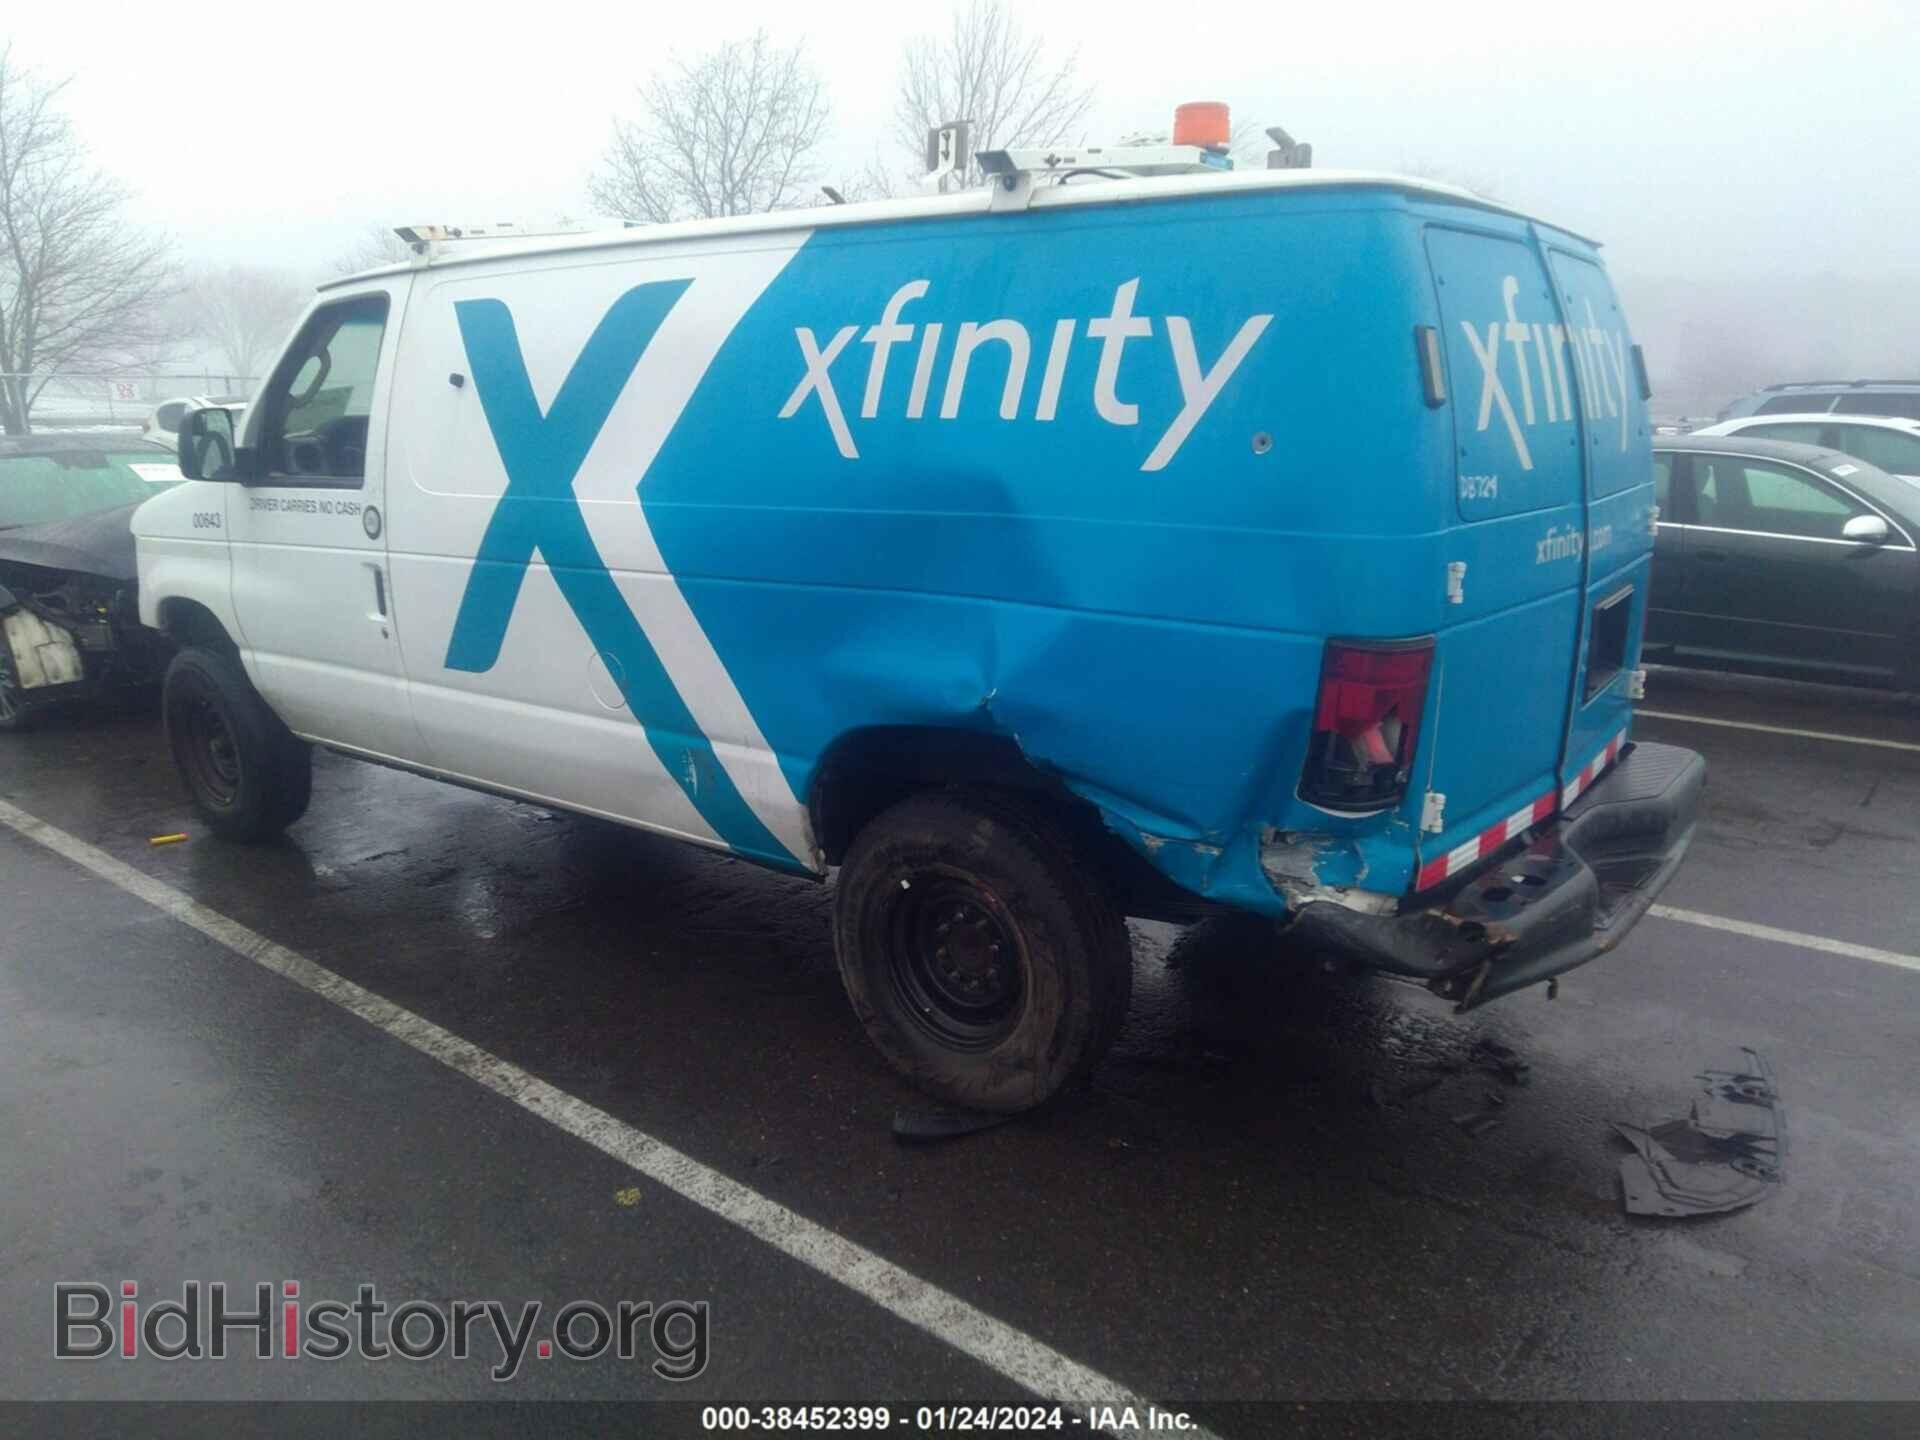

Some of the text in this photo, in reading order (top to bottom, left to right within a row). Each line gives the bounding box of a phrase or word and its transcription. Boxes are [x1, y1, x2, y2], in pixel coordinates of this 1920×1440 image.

[776, 277, 1275, 472] xfinity
[1461, 275, 1628, 471] xfinity
[193, 512, 222, 528] 00643
[250, 497, 361, 516] DRIVER CARRIES NO CASH
